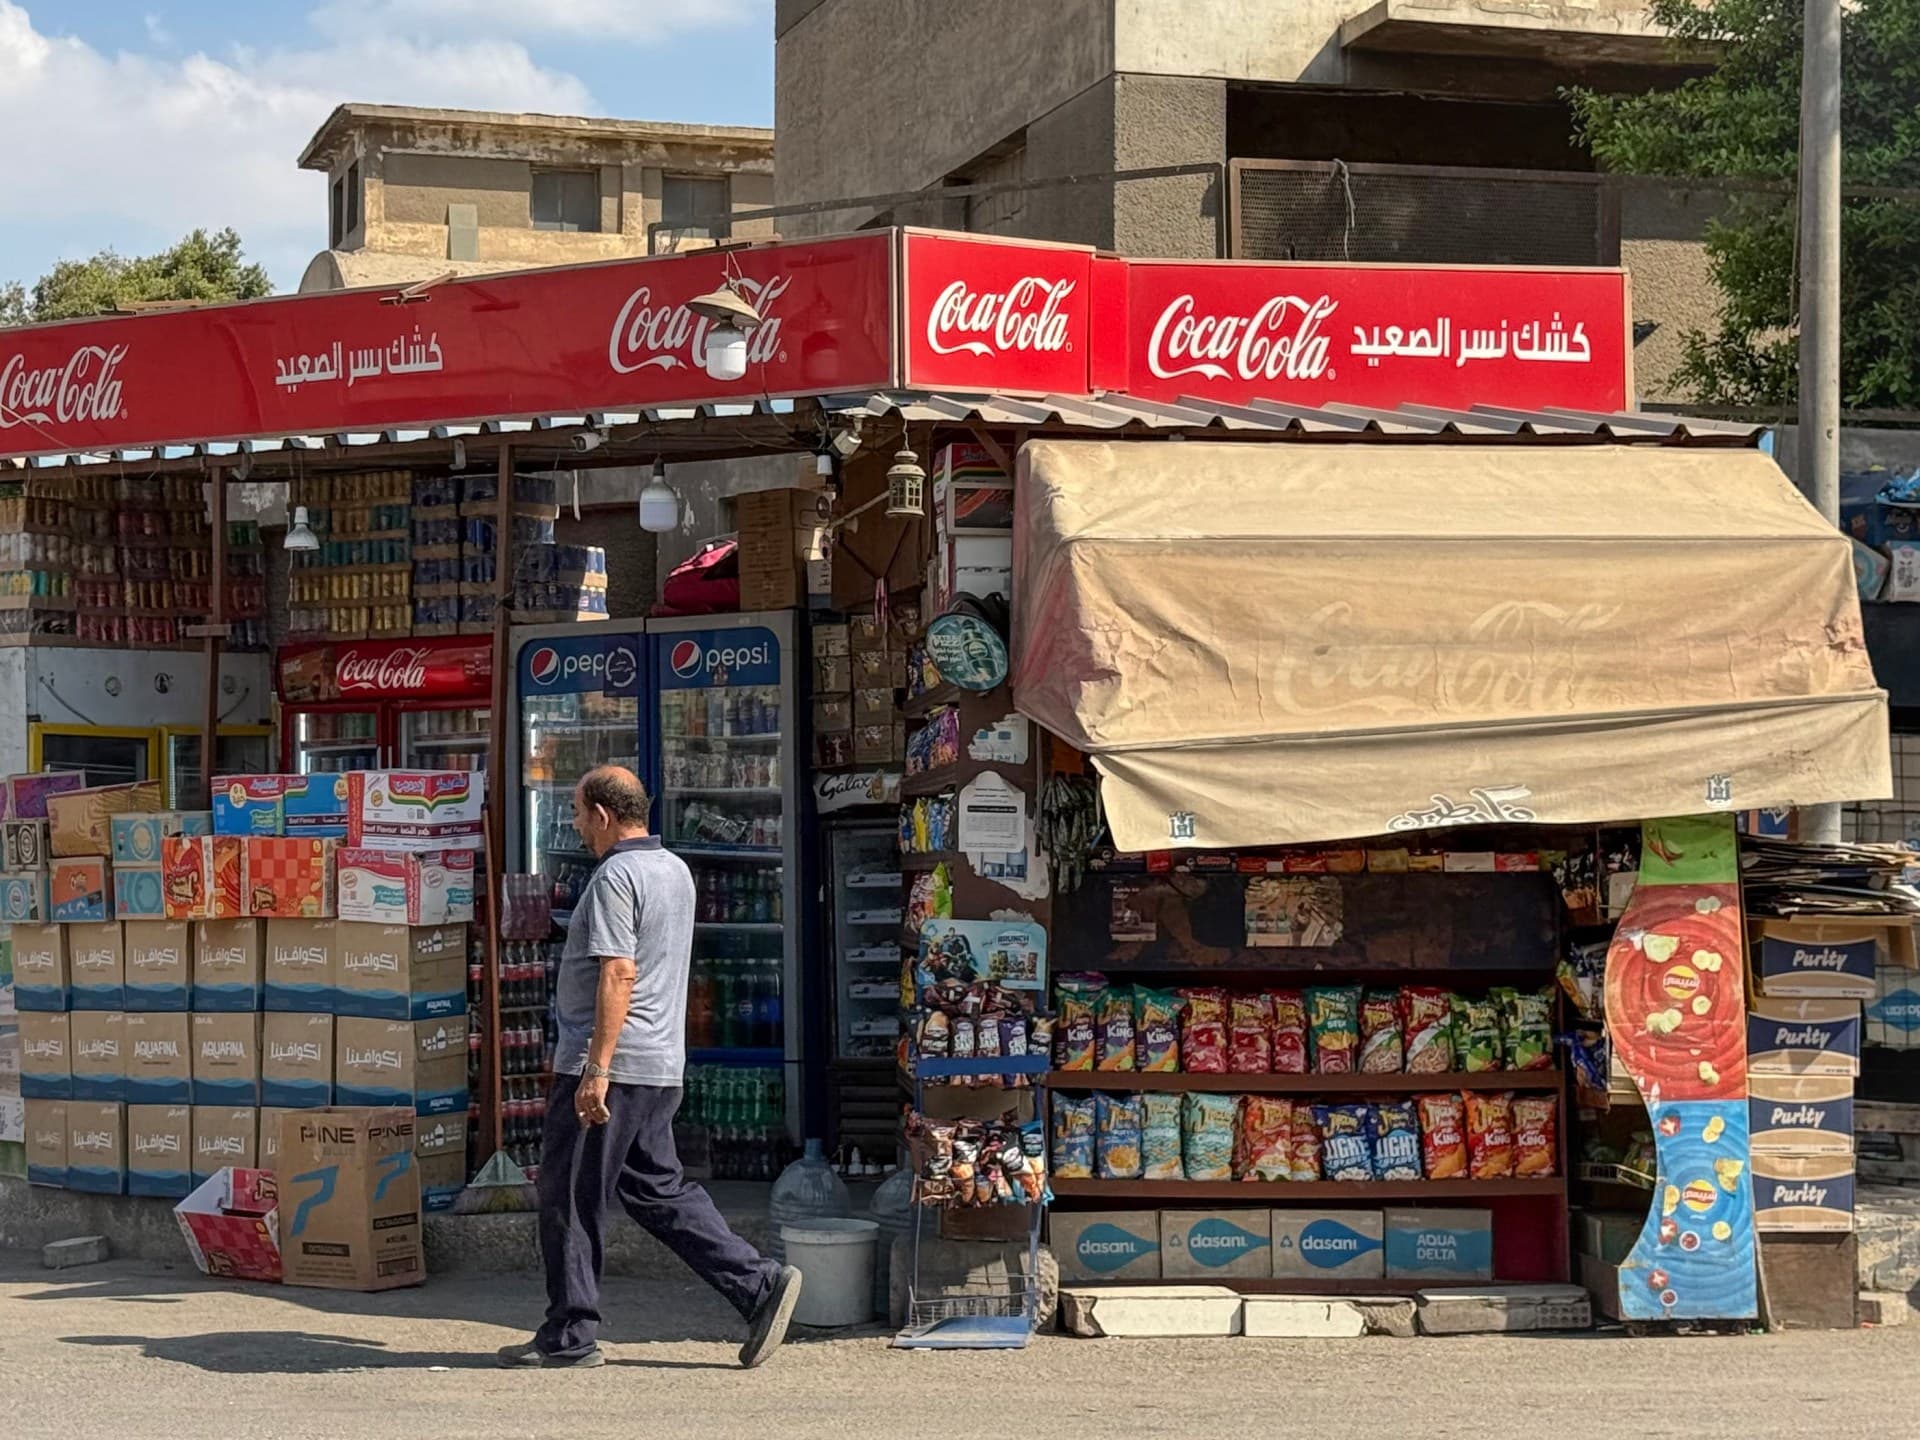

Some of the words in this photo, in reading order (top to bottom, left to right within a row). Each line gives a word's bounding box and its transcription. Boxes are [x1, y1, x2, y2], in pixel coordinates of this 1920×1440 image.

[609, 274, 793, 374] CocaCla
[927, 276, 1077, 358] Coca-Cola
[1148, 294, 1339, 380] Coca-Cola
[1351, 317, 1450, 366] الصعيد
[1456, 320, 1507, 367] نسر
[1512, 312, 1591, 362] كشك
[386, 325, 443, 374] كشك
[275, 341, 343, 393] الصعيد
[0, 344, 129, 428] Coca-Cola
[336, 648, 432, 690] Coca-Cola
[563, 653, 604, 679] pep
[706, 642, 770, 673] pepsi
[1792, 948, 1848, 971] Purity
[1775, 1025, 1831, 1048] Purity
[134, 1041, 181, 1058] AQUAFINA
[201, 1041, 247, 1059] AQUAFINA
[1771, 1105, 1825, 1128] Purity
[301, 1126, 356, 1144] PINE
[369, 1124, 413, 1141] PINE
[1325, 1136, 1366, 1160] LIGHT
[1376, 1134, 1418, 1158] LIGHT
[1773, 1183, 1827, 1205] Purity
[1079, 1239, 1136, 1255] dasani
[1190, 1233, 1247, 1248] dasani
[1302, 1235, 1357, 1250] dasani
[1416, 1234, 1457, 1247] AQUA
[1416, 1248, 1457, 1261] DELTA
